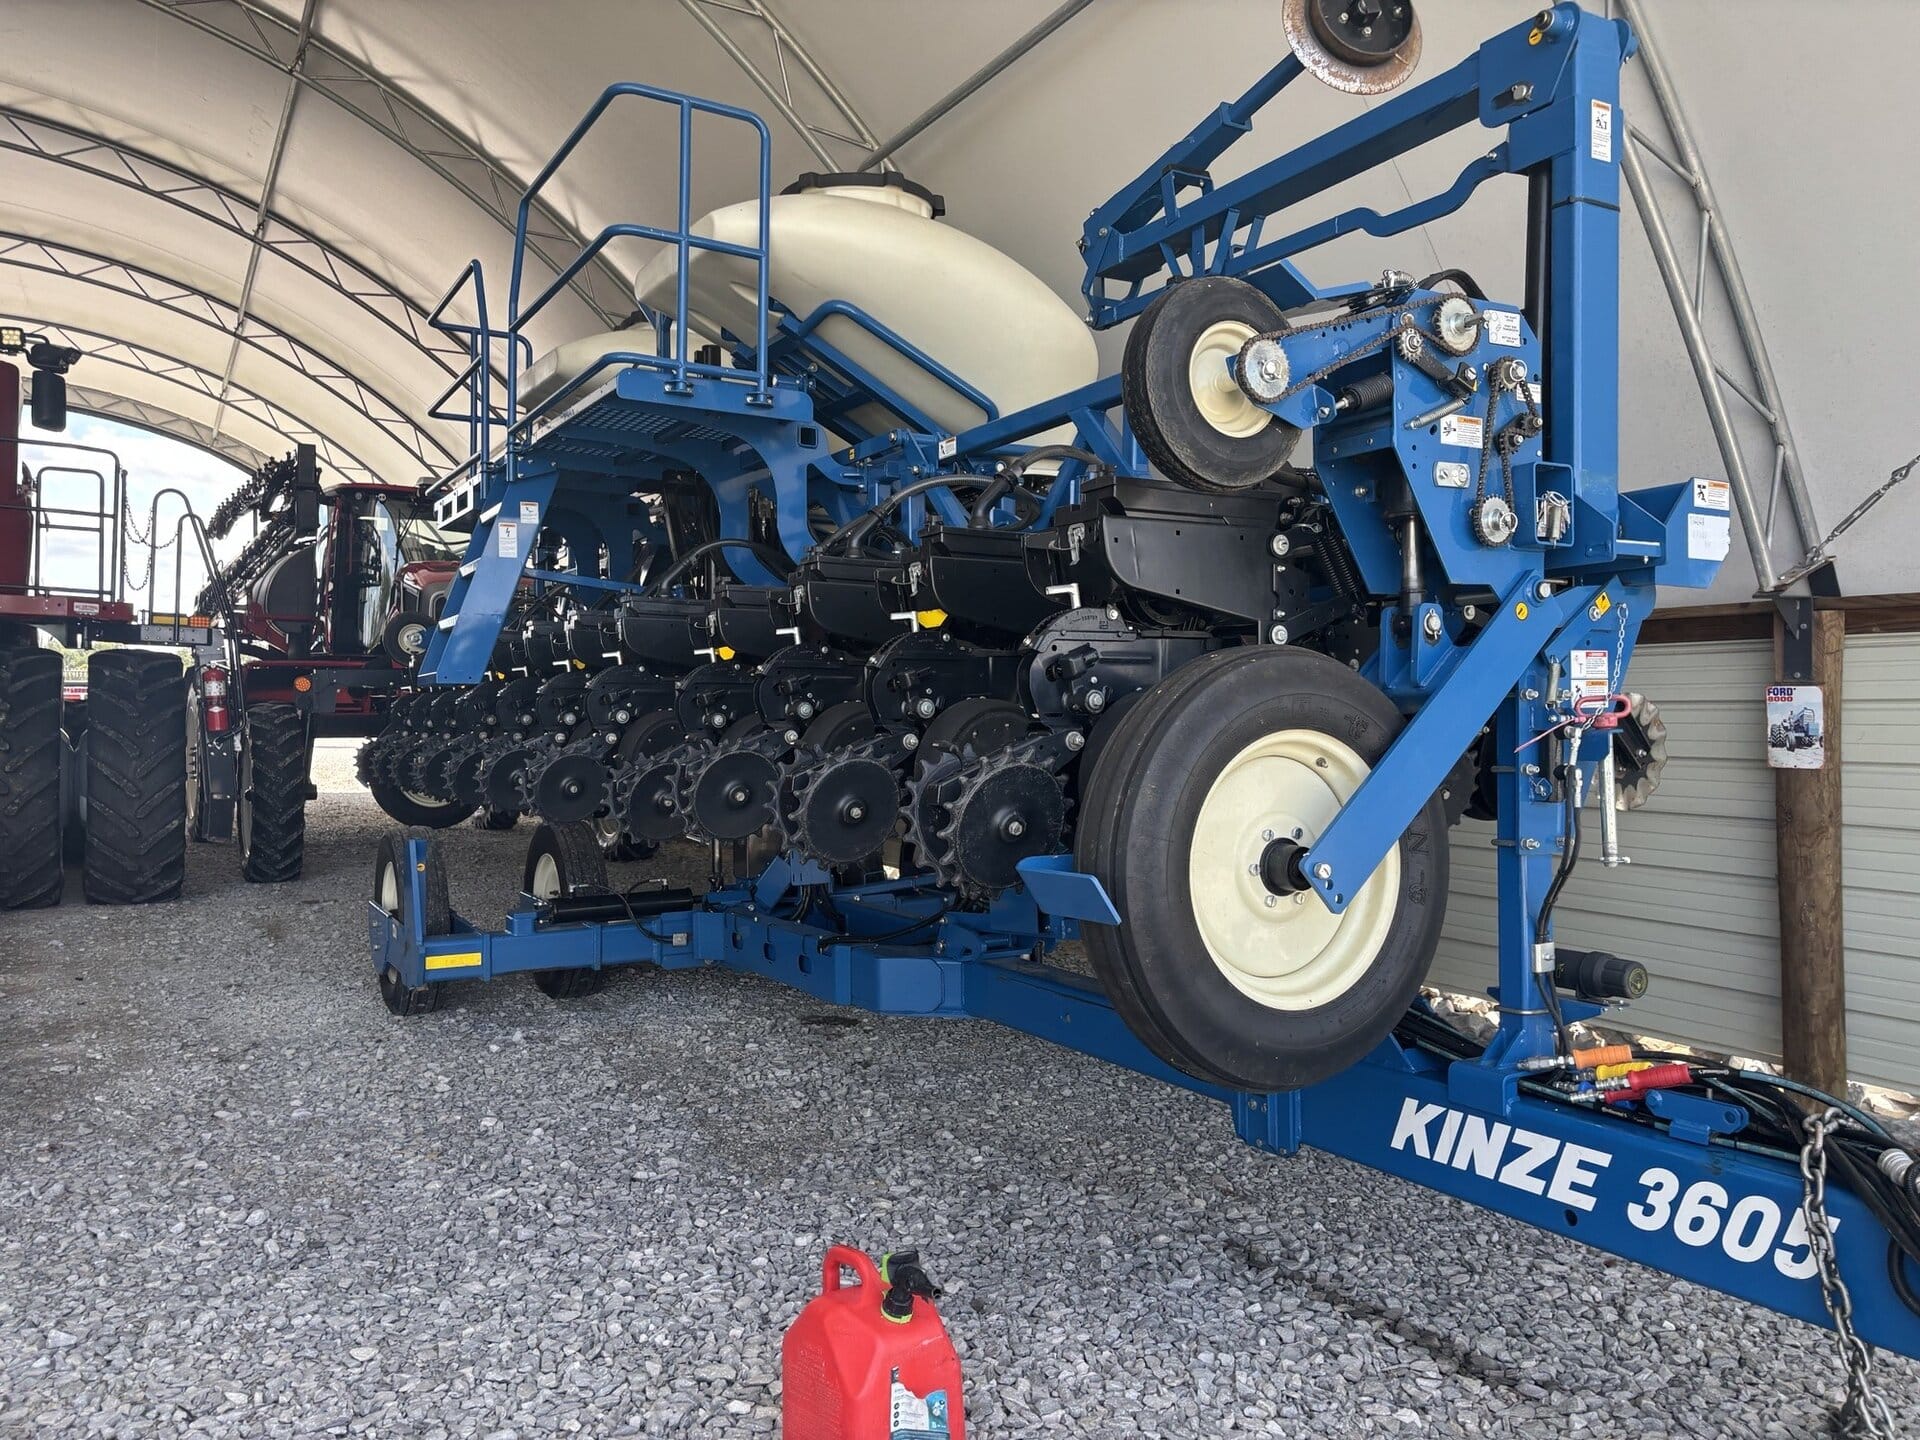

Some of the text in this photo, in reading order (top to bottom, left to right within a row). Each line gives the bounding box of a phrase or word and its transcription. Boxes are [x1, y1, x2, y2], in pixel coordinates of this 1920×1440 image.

[1767, 687, 1793, 696] FORD
[1390, 1097, 1841, 1280] KINZE 3605
